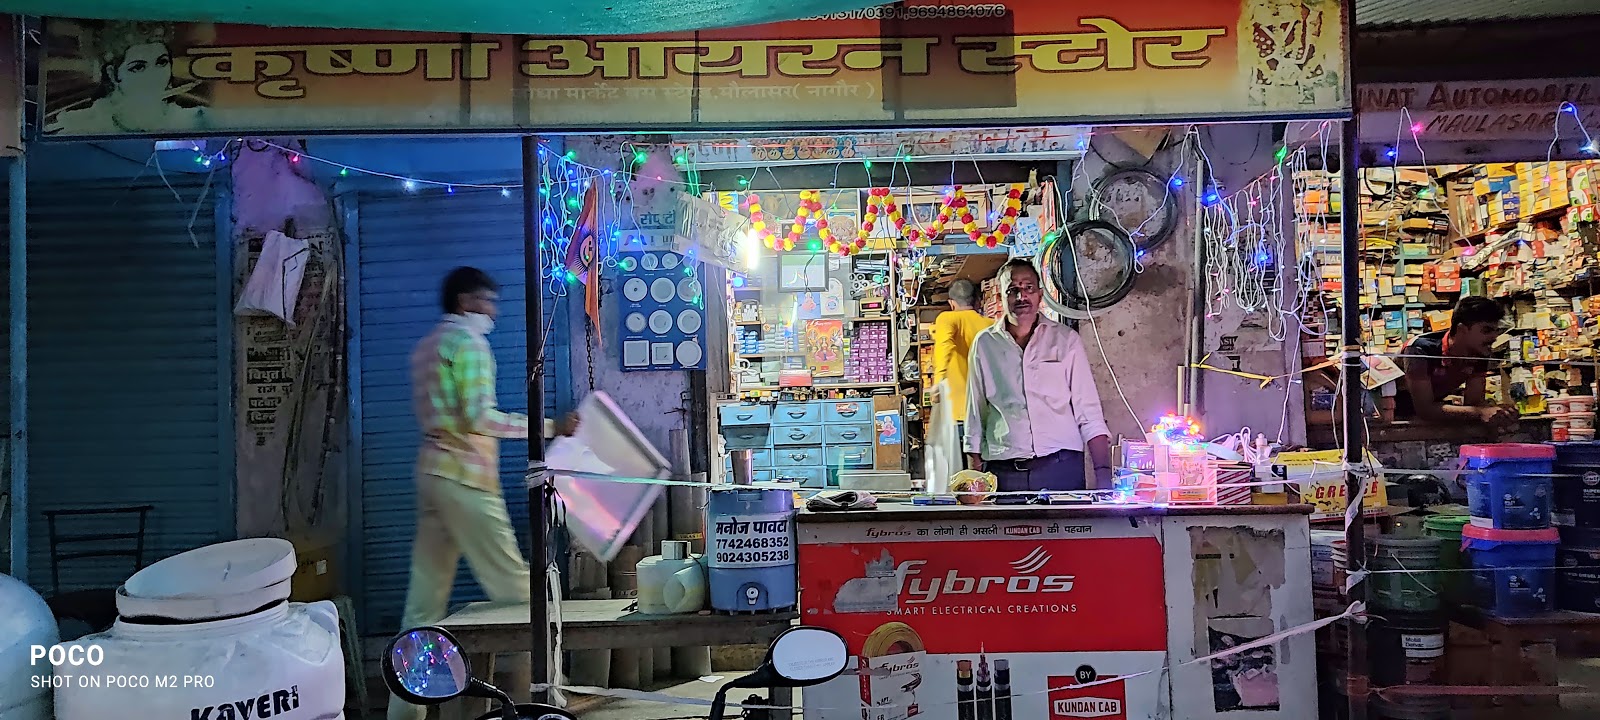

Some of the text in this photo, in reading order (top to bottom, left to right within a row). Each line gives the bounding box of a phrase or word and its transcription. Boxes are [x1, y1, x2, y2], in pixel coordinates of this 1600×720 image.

[186, 17, 1228, 99] कृष्णा आयरन स्टोर
[1315, 481, 1379, 499] GREE
[716, 517, 788, 535] मनोज पावटा
[917, 524, 998, 536] का लोगो ही असली
[1047, 523, 1092, 534] की पहचान
[716, 537, 789, 549] 7742468352
[716, 550, 789, 563] 9024305238
[897, 560, 1075, 604] fybros
[932, 605, 1002, 615] ELECTRICAL
[1007, 604, 1077, 614] CREATIONS
[1080, 671, 1092, 679] BY
[1058, 701, 1117, 712] KUNDAN CAB
